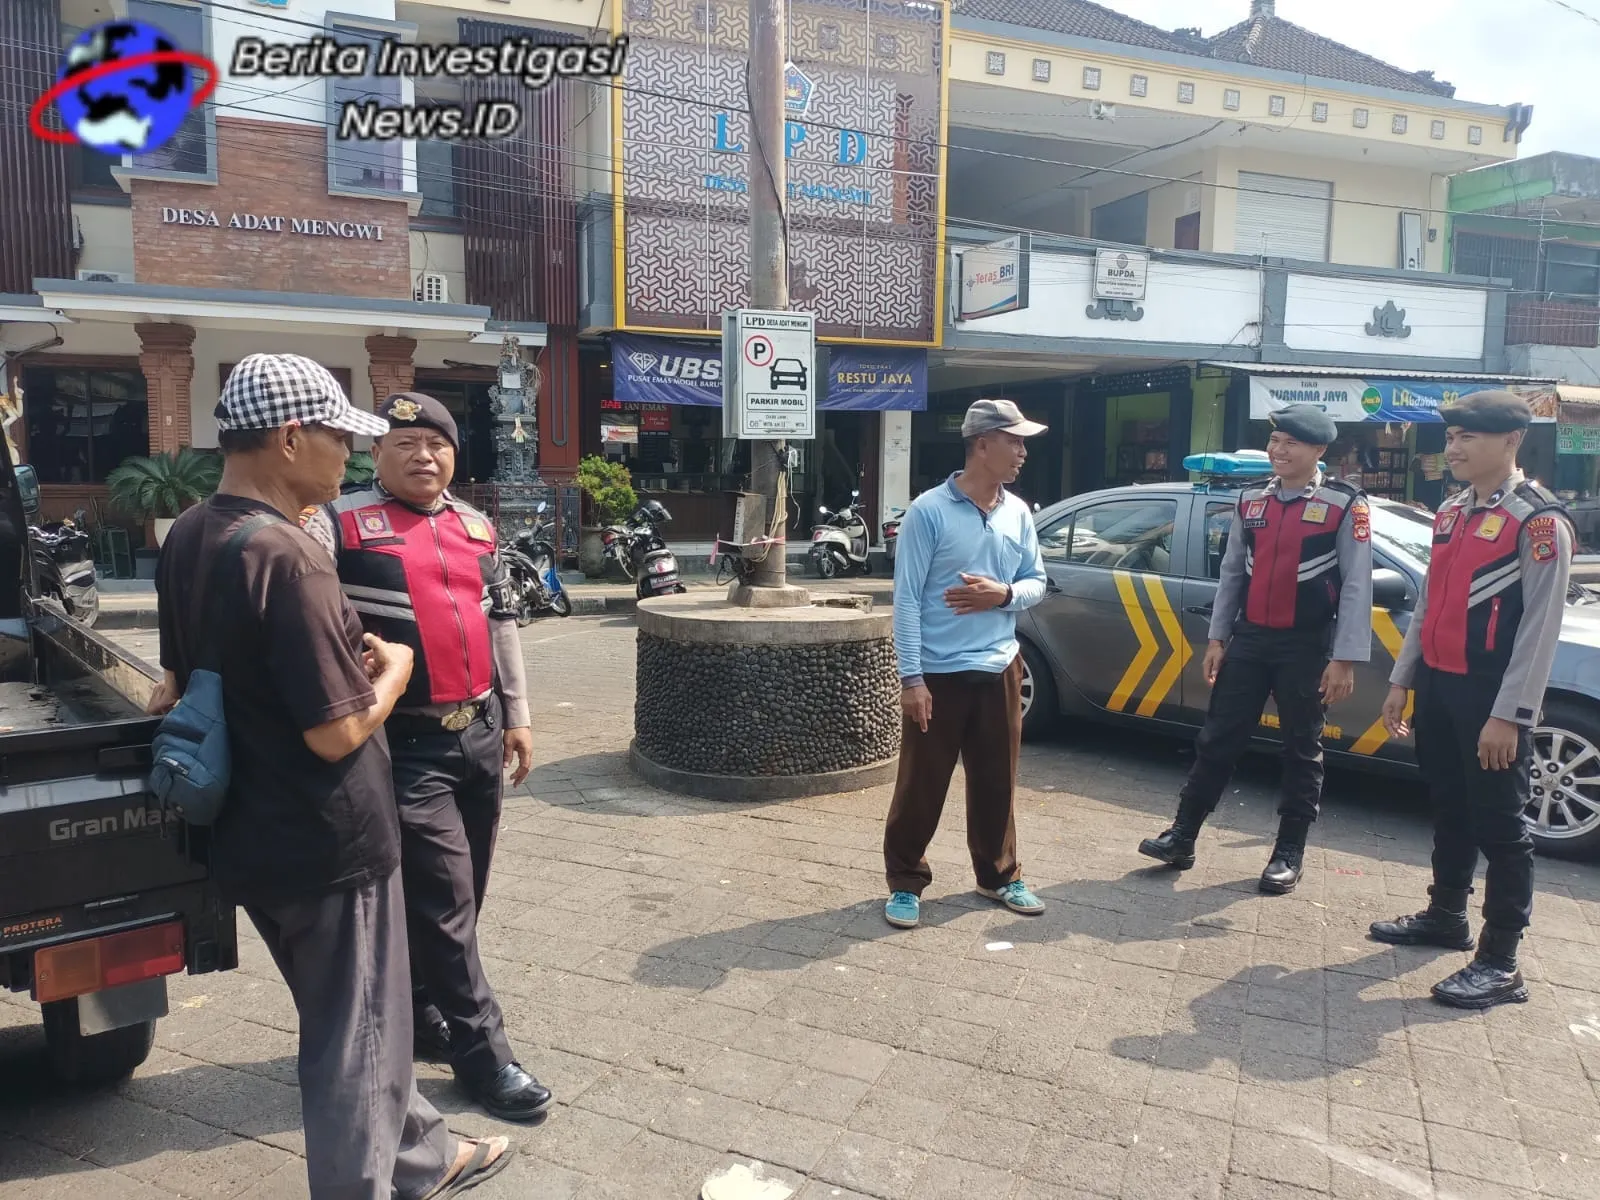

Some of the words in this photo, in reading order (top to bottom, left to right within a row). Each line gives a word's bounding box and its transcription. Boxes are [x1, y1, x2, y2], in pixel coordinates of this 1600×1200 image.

[162, 207, 220, 228] DESA
[227, 212, 285, 232] ADAT
[290, 217, 384, 241] MENGWI
[976, 271, 998, 287] Teras
[1000, 263, 1015, 279] BRI
[1107, 269, 1136, 278] BUPDA
[746, 317, 766, 326] LPD
[753, 342, 766, 360] P
[659, 354, 721, 380] UBS
[628, 374, 650, 382] PUSAT
[652, 376, 672, 384] EMAS
[837, 372, 876, 384] RESTU
[881, 373, 912, 385] JAYA
[750, 397, 779, 405] PARKIR
[781, 398, 804, 406] MOBIL
[1323, 390, 1348, 402] JAYA
[50, 816, 117, 840] Gran
[3, 917, 62, 934] PROTERA
